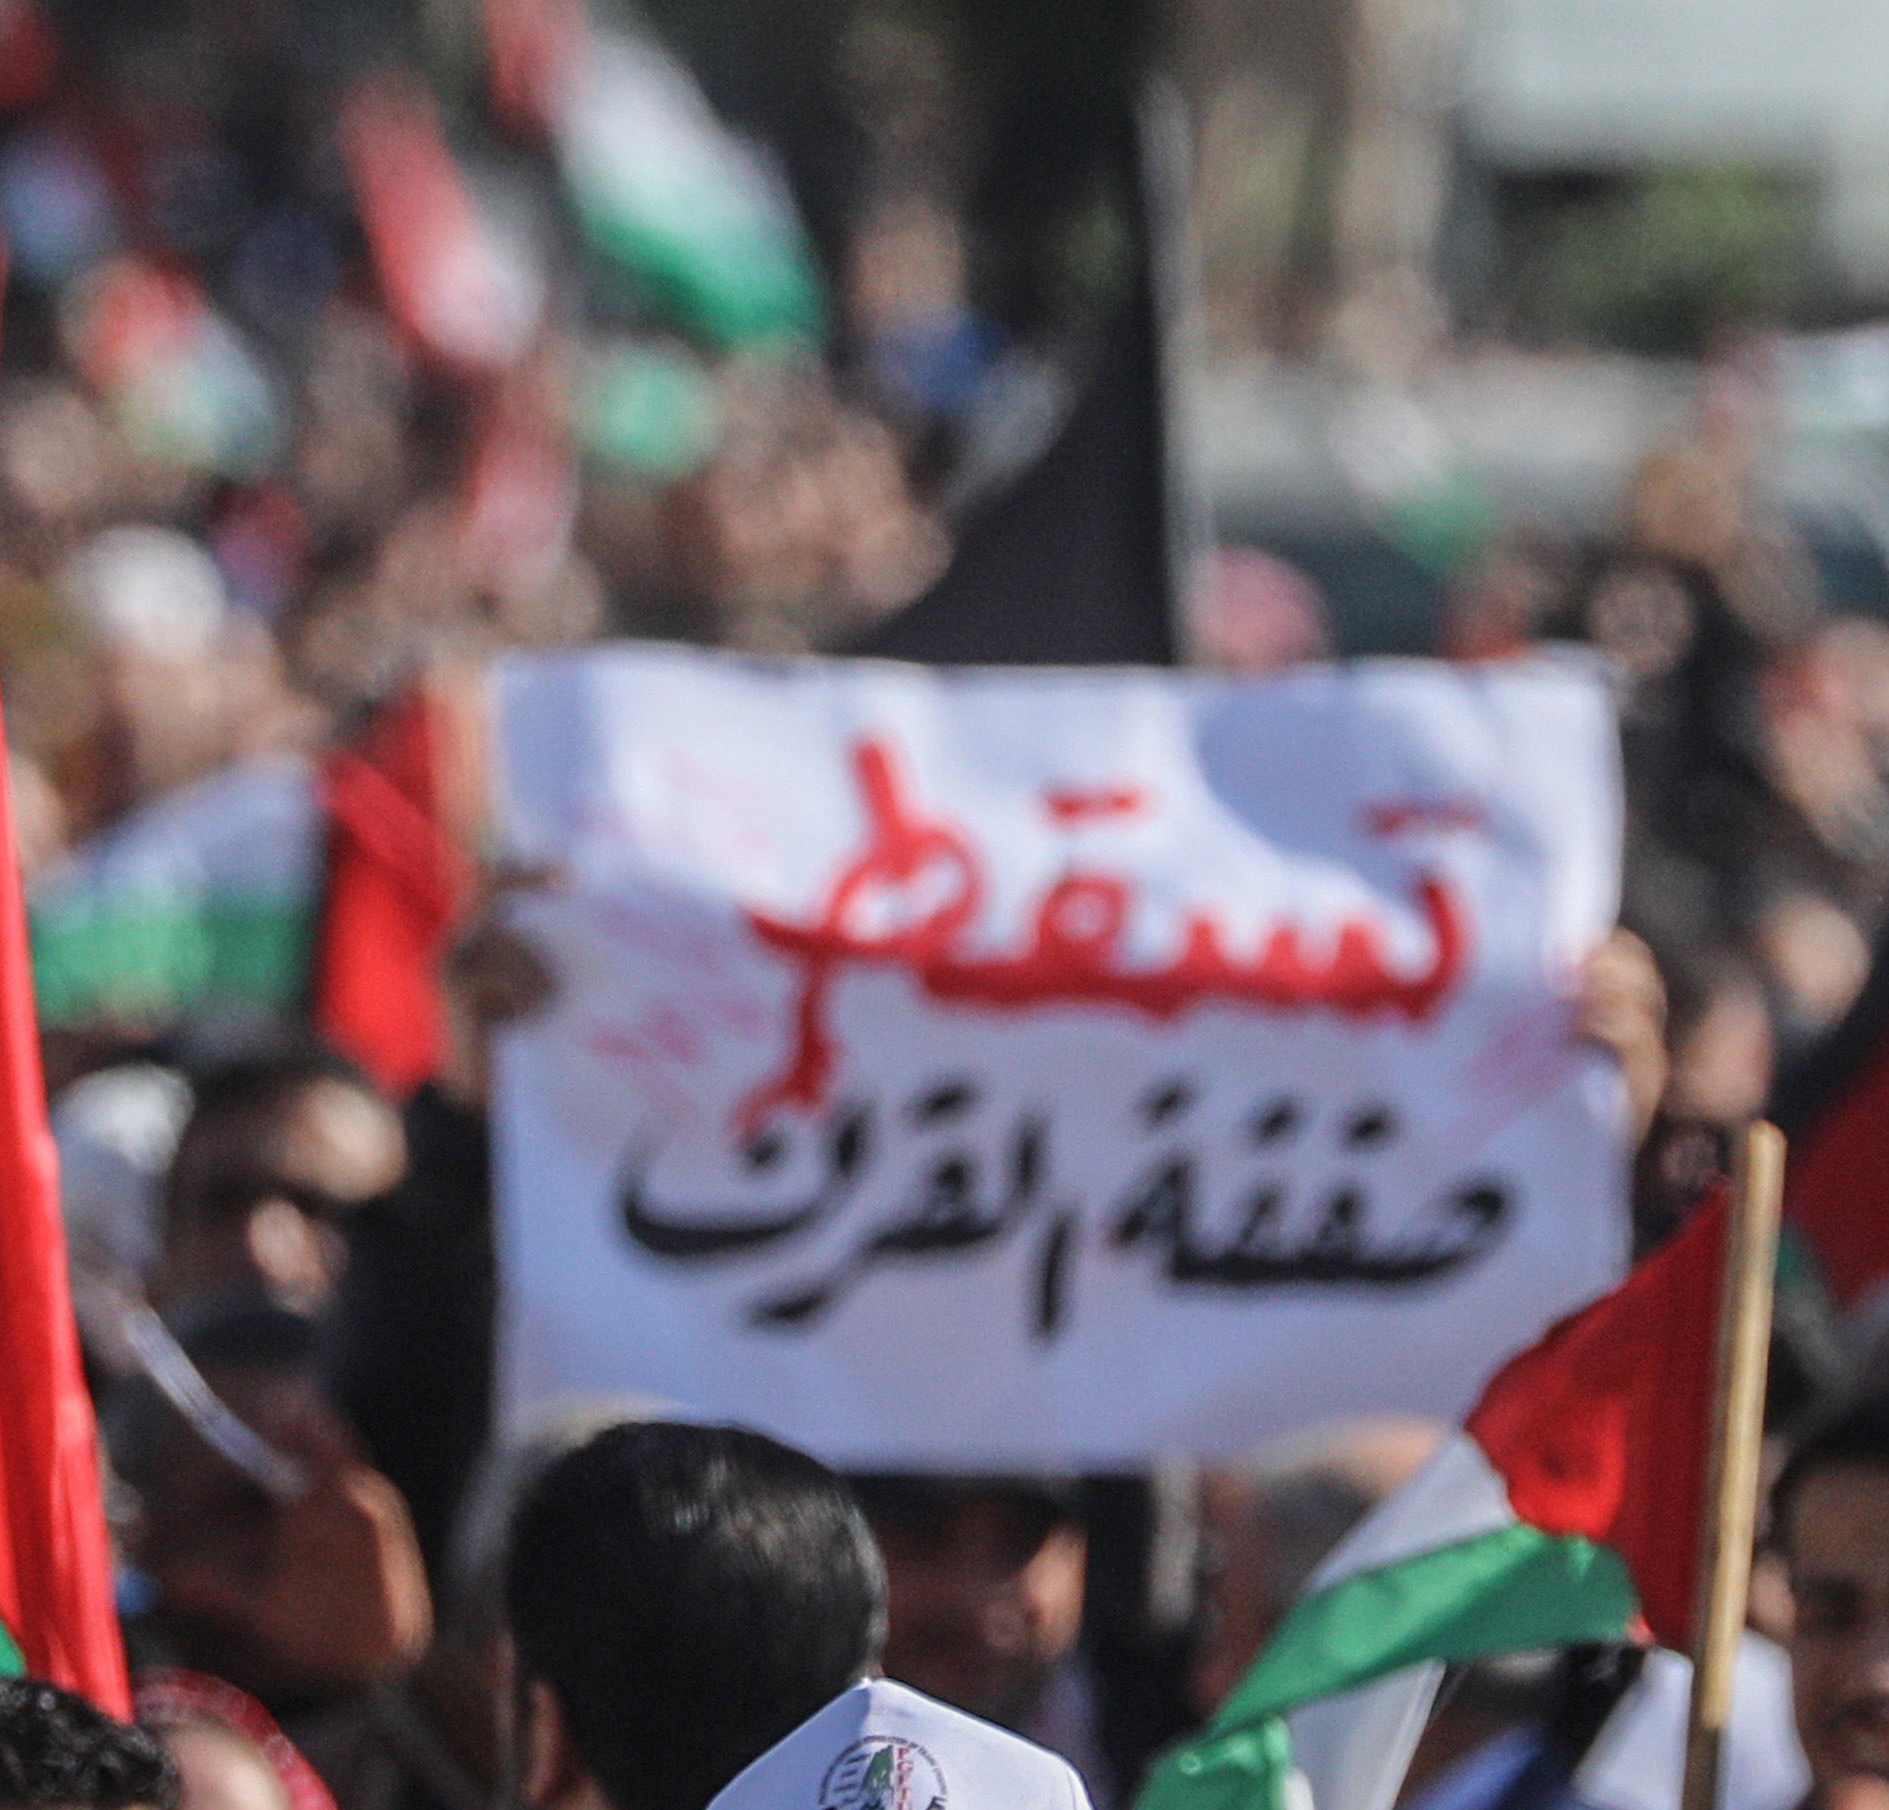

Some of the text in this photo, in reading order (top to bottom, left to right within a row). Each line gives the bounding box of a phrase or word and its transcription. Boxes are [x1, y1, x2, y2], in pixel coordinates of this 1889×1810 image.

[742, 732, 1472, 1142] تسقط
[618, 1080, 1520, 1346] صفقة القرن
